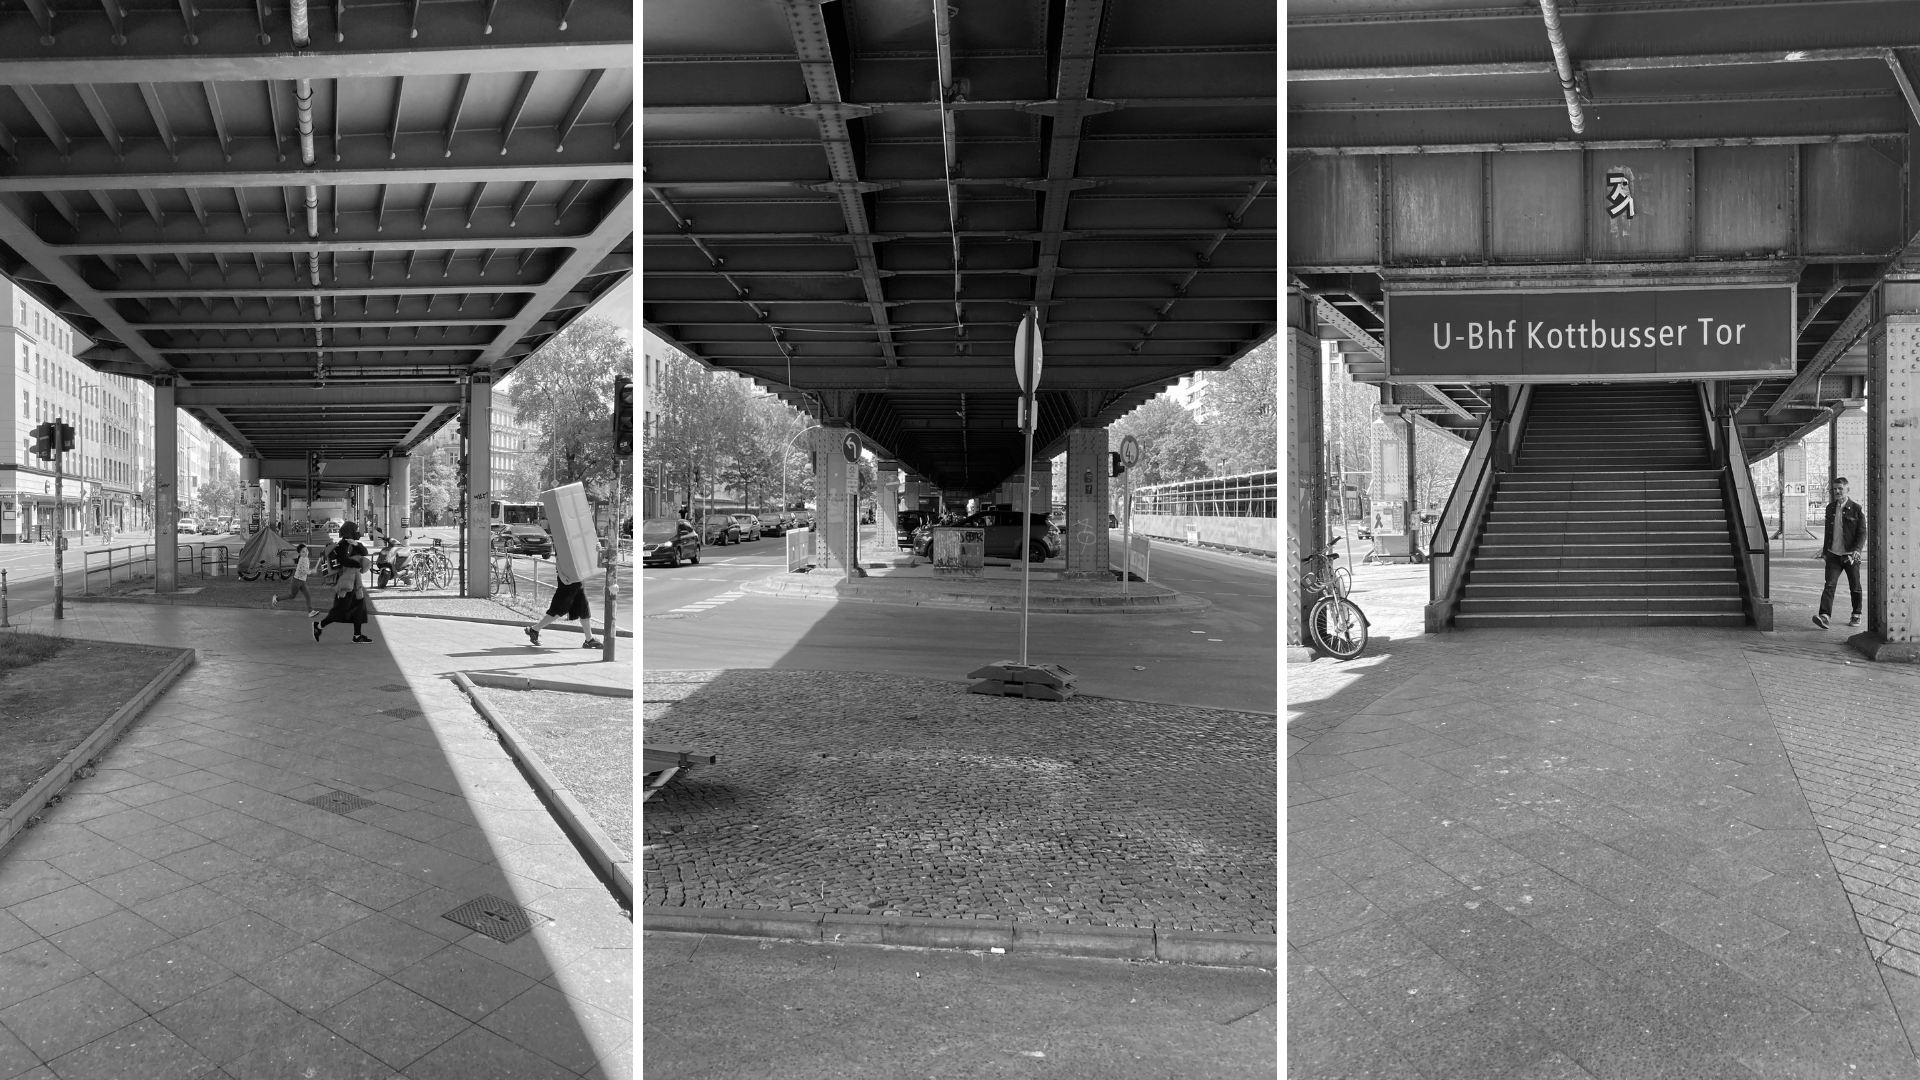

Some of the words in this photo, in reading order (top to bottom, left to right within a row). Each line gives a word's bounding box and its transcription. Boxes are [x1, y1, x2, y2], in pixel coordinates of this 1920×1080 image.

[1433, 320, 1516, 350] U-Bhf
[1528, 319, 1688, 350] Kottbusser
[1697, 317, 1746, 346] Tor
